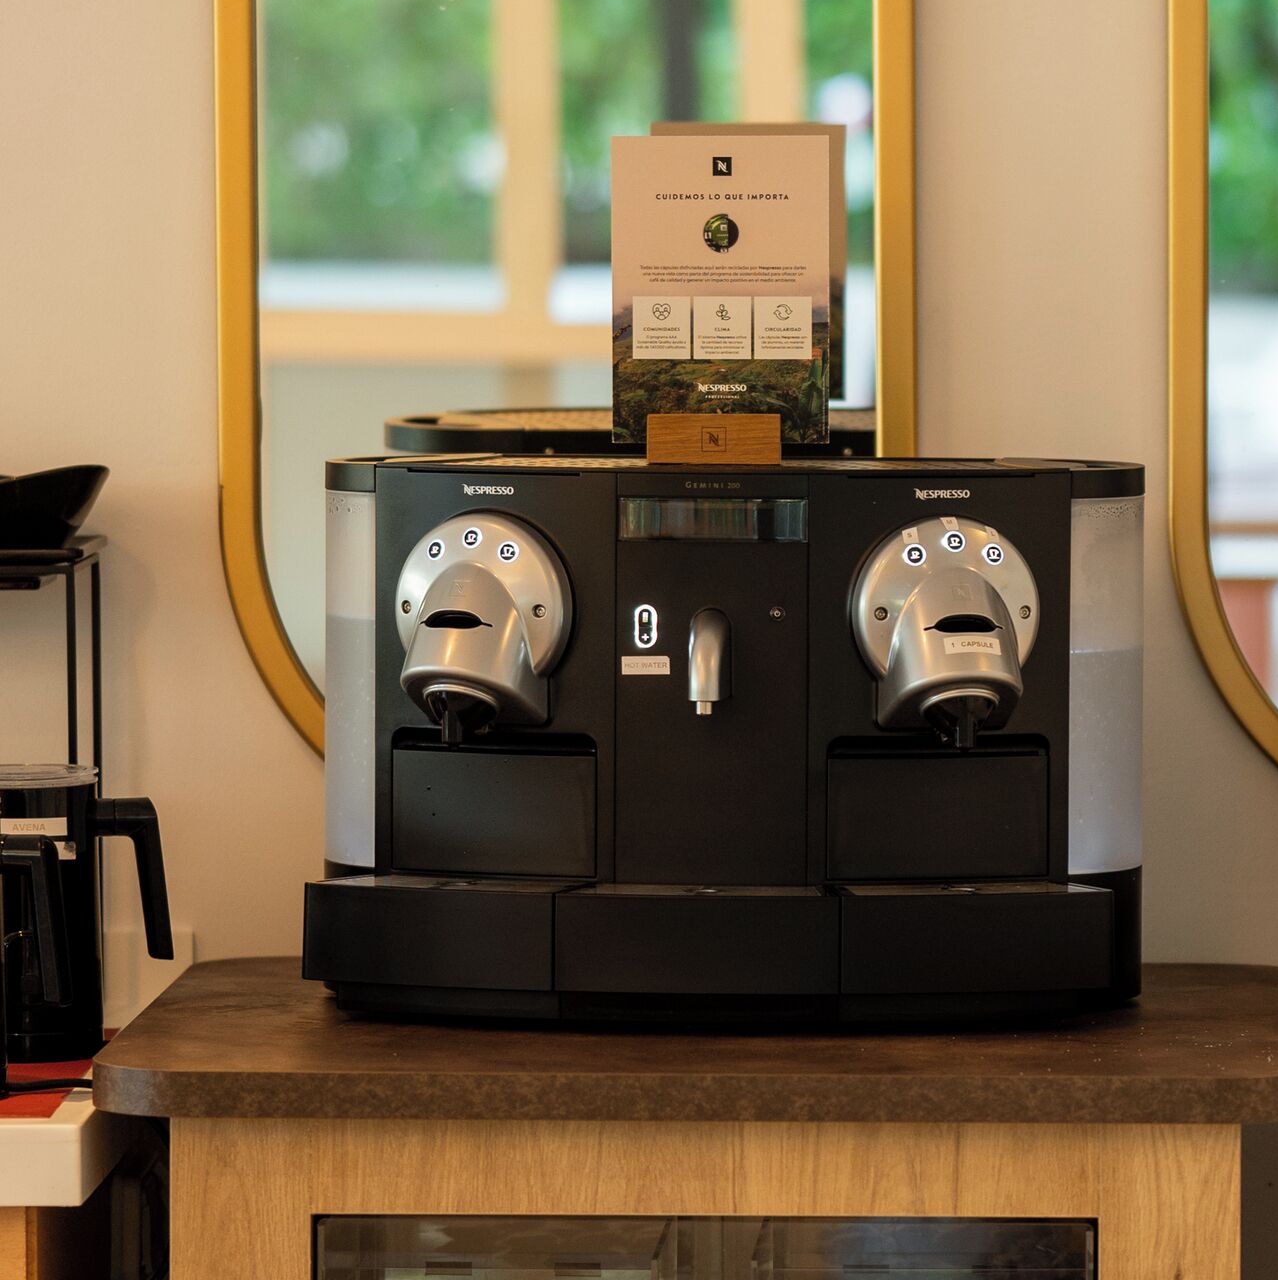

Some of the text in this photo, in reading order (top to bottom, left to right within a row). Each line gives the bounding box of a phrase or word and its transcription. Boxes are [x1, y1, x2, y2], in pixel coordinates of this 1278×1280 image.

[655, 193, 790, 201] CUIDEMOS LO QUE IMPORTA
[697, 383, 747, 393] NESPRESSO
[685, 481, 724, 489] GEMINI
[461, 484, 514, 496] NESPRESSO
[914, 488, 970, 500] NESPRESSO
[960, 641, 994, 649] CAPSULE
[12, 823, 46, 832] AVENA
